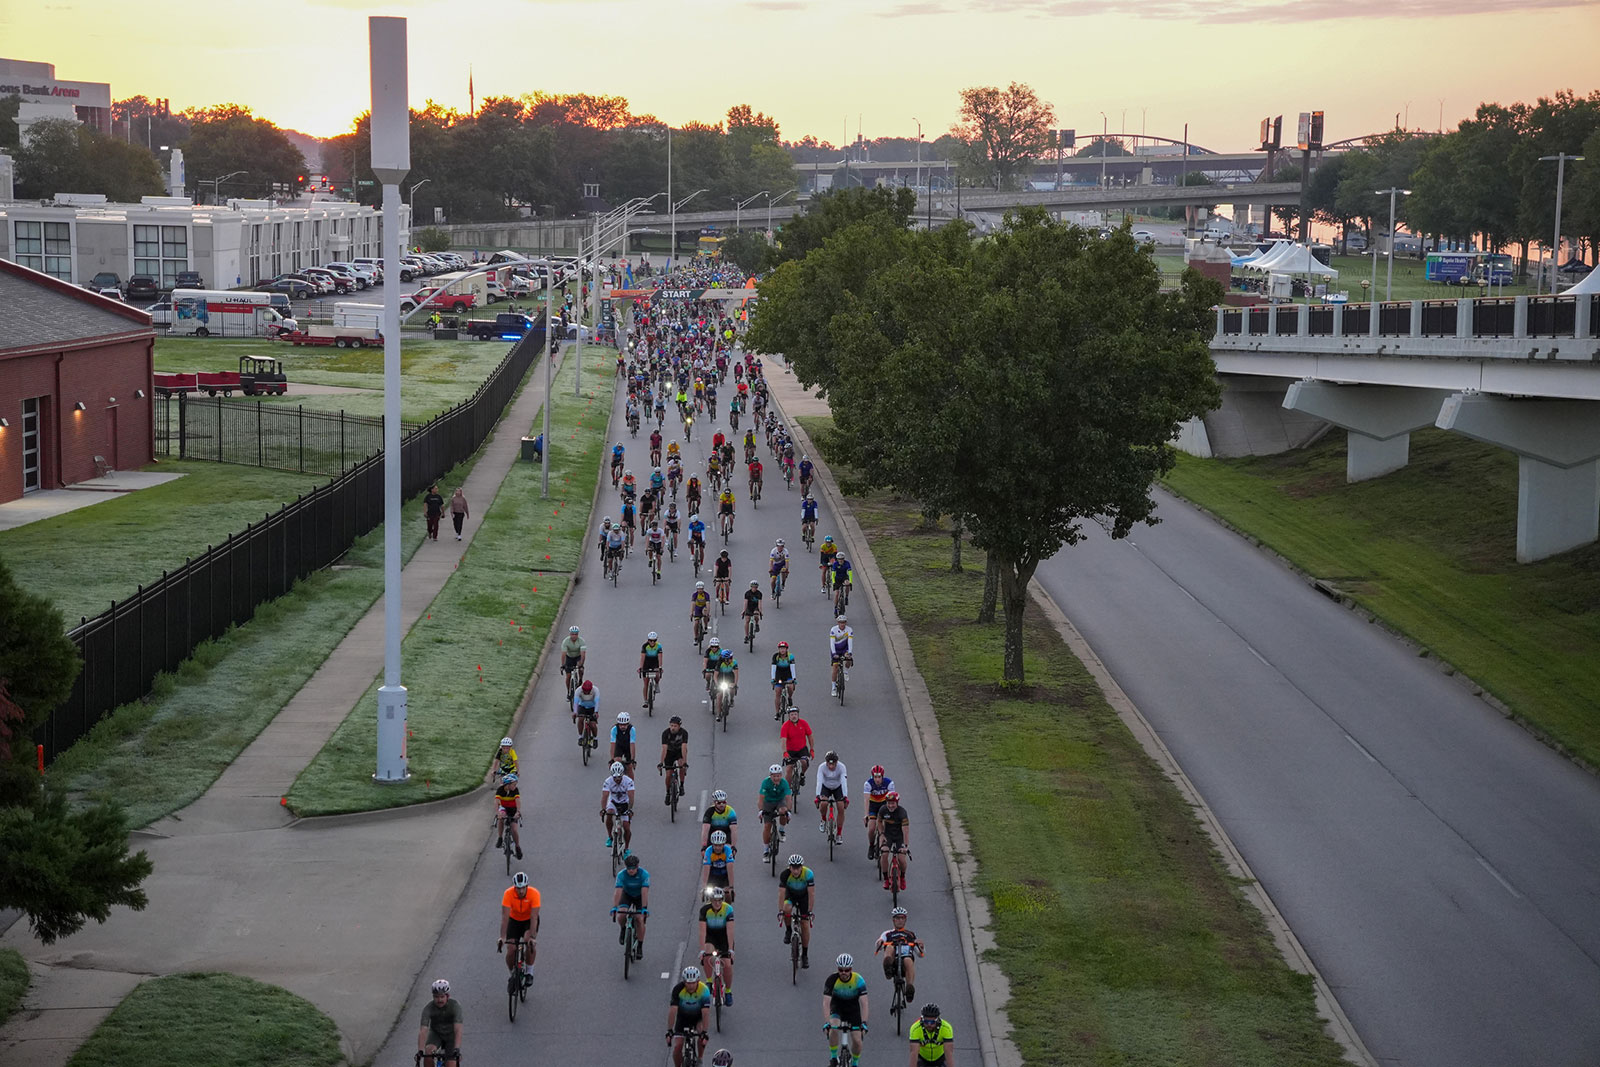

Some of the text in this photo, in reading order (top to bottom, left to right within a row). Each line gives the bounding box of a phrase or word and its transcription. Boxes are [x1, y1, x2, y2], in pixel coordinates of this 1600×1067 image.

[22, 84, 50, 95] Bank
[51, 86, 80, 98] Arena
[662, 290, 691, 298] START
